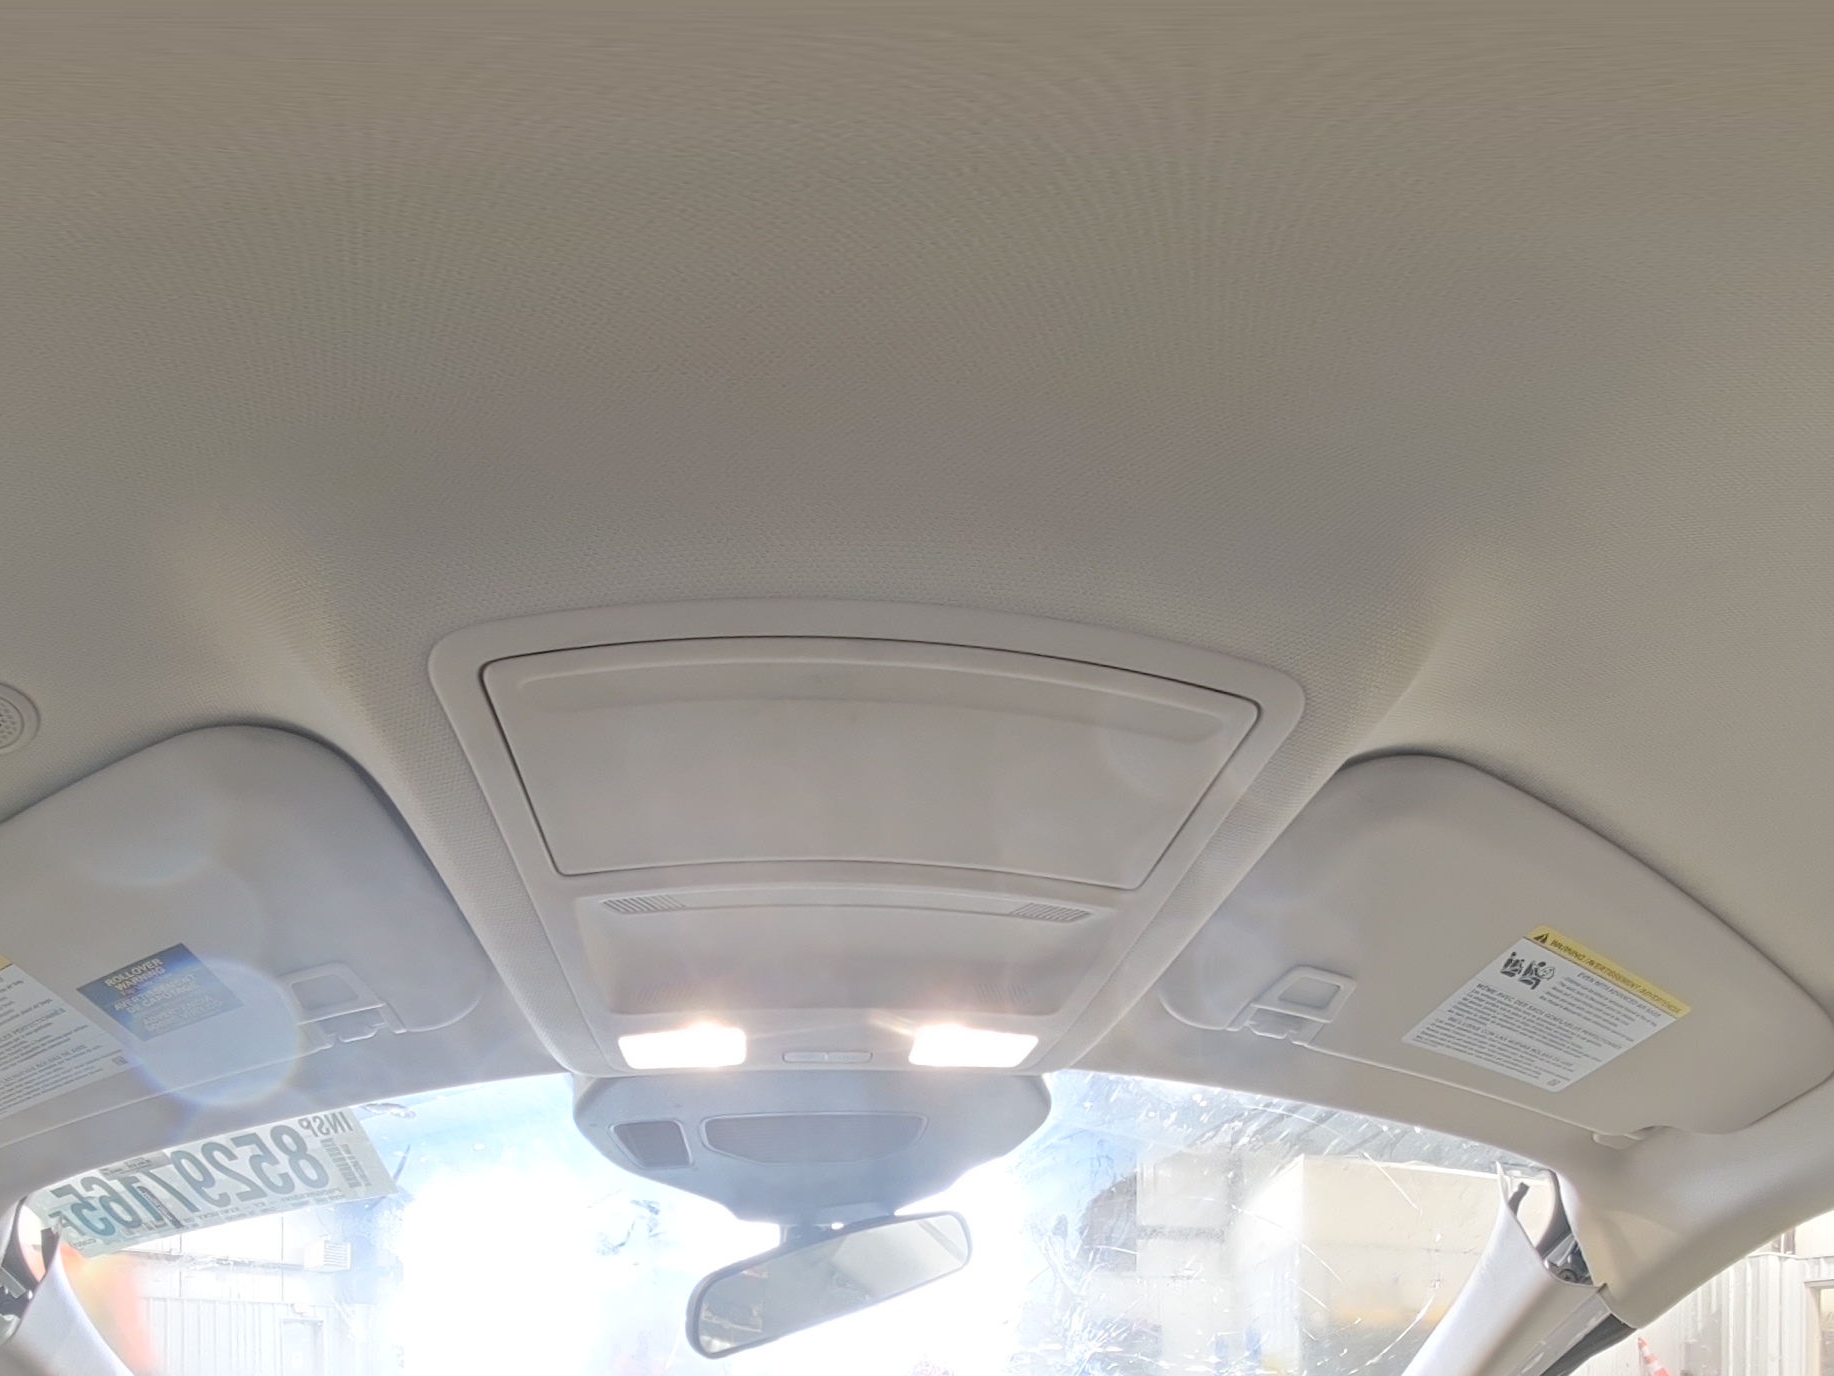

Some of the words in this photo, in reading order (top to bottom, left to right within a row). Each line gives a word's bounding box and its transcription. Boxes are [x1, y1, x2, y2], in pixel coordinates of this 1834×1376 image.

[104, 958, 163, 986] ROLLOVER
[115, 966, 166, 991] WARNING
[114, 973, 196, 1011] AVERTISSEMENT
[126, 1003, 143, 1014] DE
